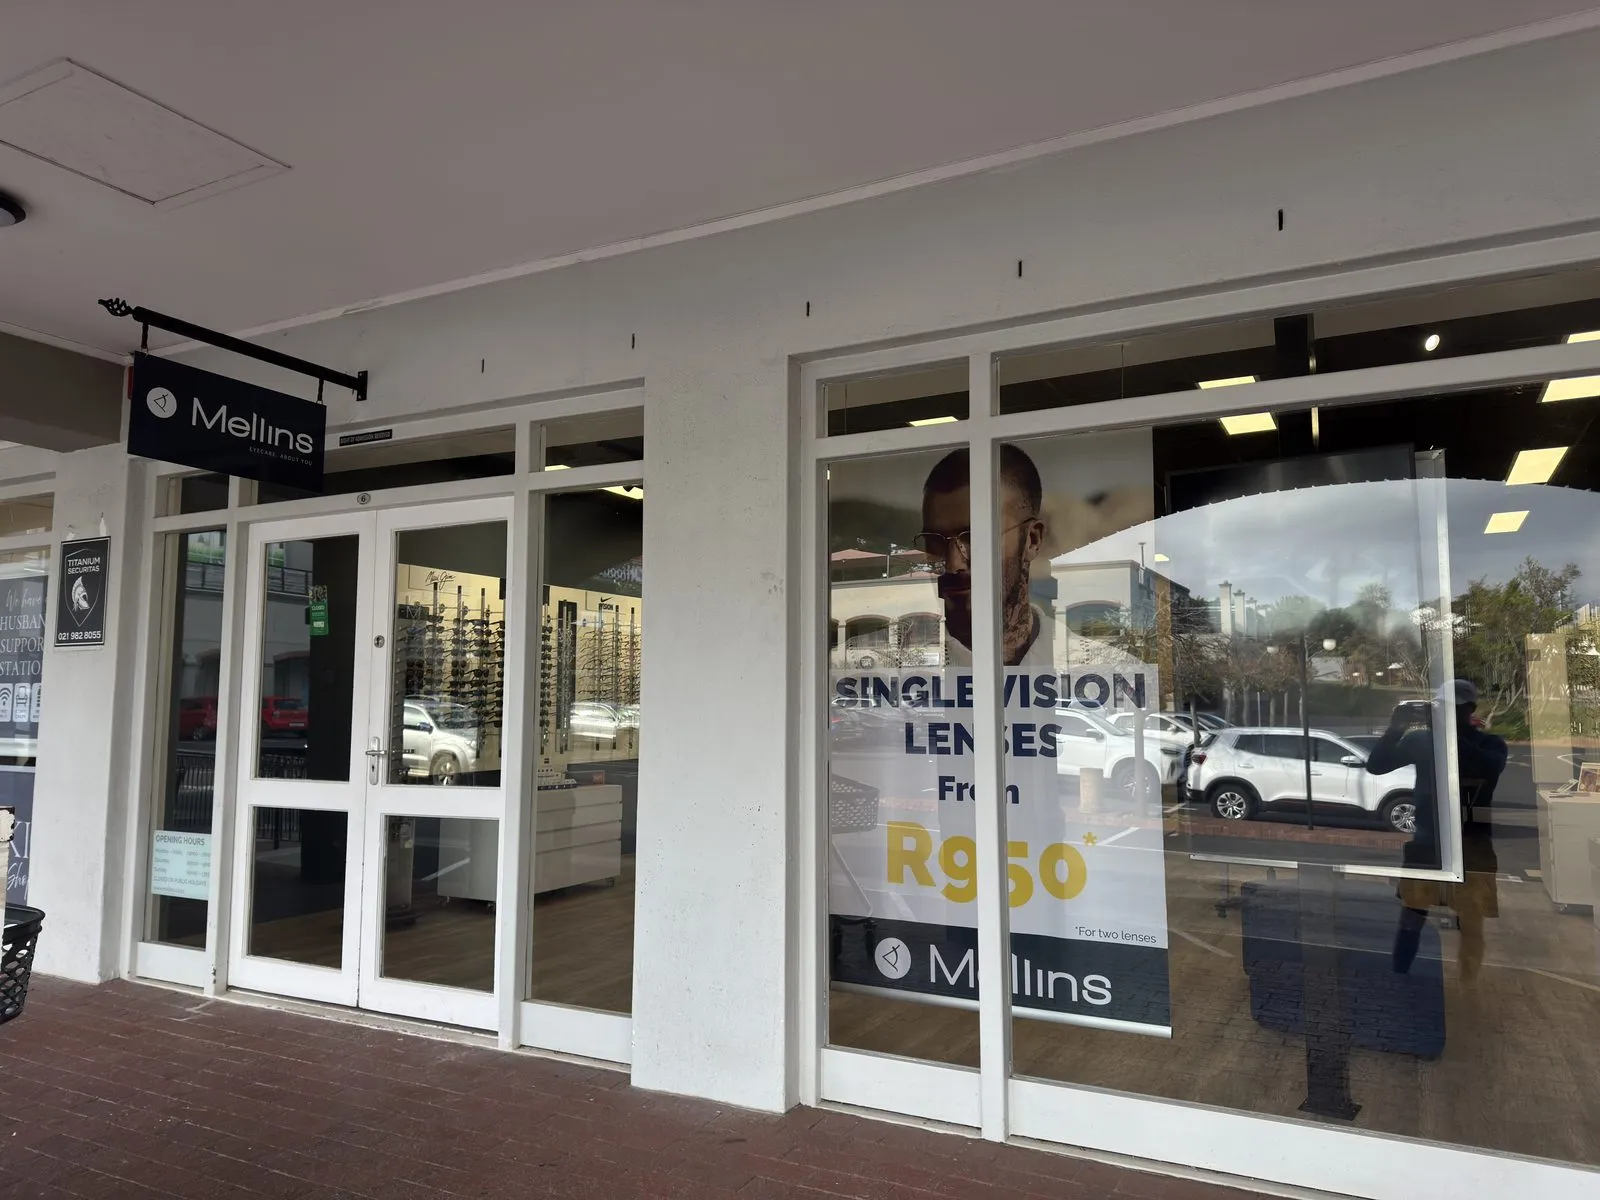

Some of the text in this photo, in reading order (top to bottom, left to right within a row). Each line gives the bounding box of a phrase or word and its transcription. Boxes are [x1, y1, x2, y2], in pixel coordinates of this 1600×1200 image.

[191, 396, 313, 454] Mellins
[279, 453, 299, 463] ABOUT
[300, 458, 313, 467] YOU
[67, 556, 101, 568] TITANIUM
[67, 565, 100, 575] SECURITAS
[57, 630, 102, 641] 021 982 8055
[835, 675, 973, 708] SINGLE
[905, 722, 1063, 757] LENES
[938, 775, 1020, 804] Fr
[155, 834, 206, 846] OPENING HOURS
[1098, 928, 1119, 940] two
[1121, 930, 1157, 944] lenses
[929, 943, 1112, 1006] Mllins
